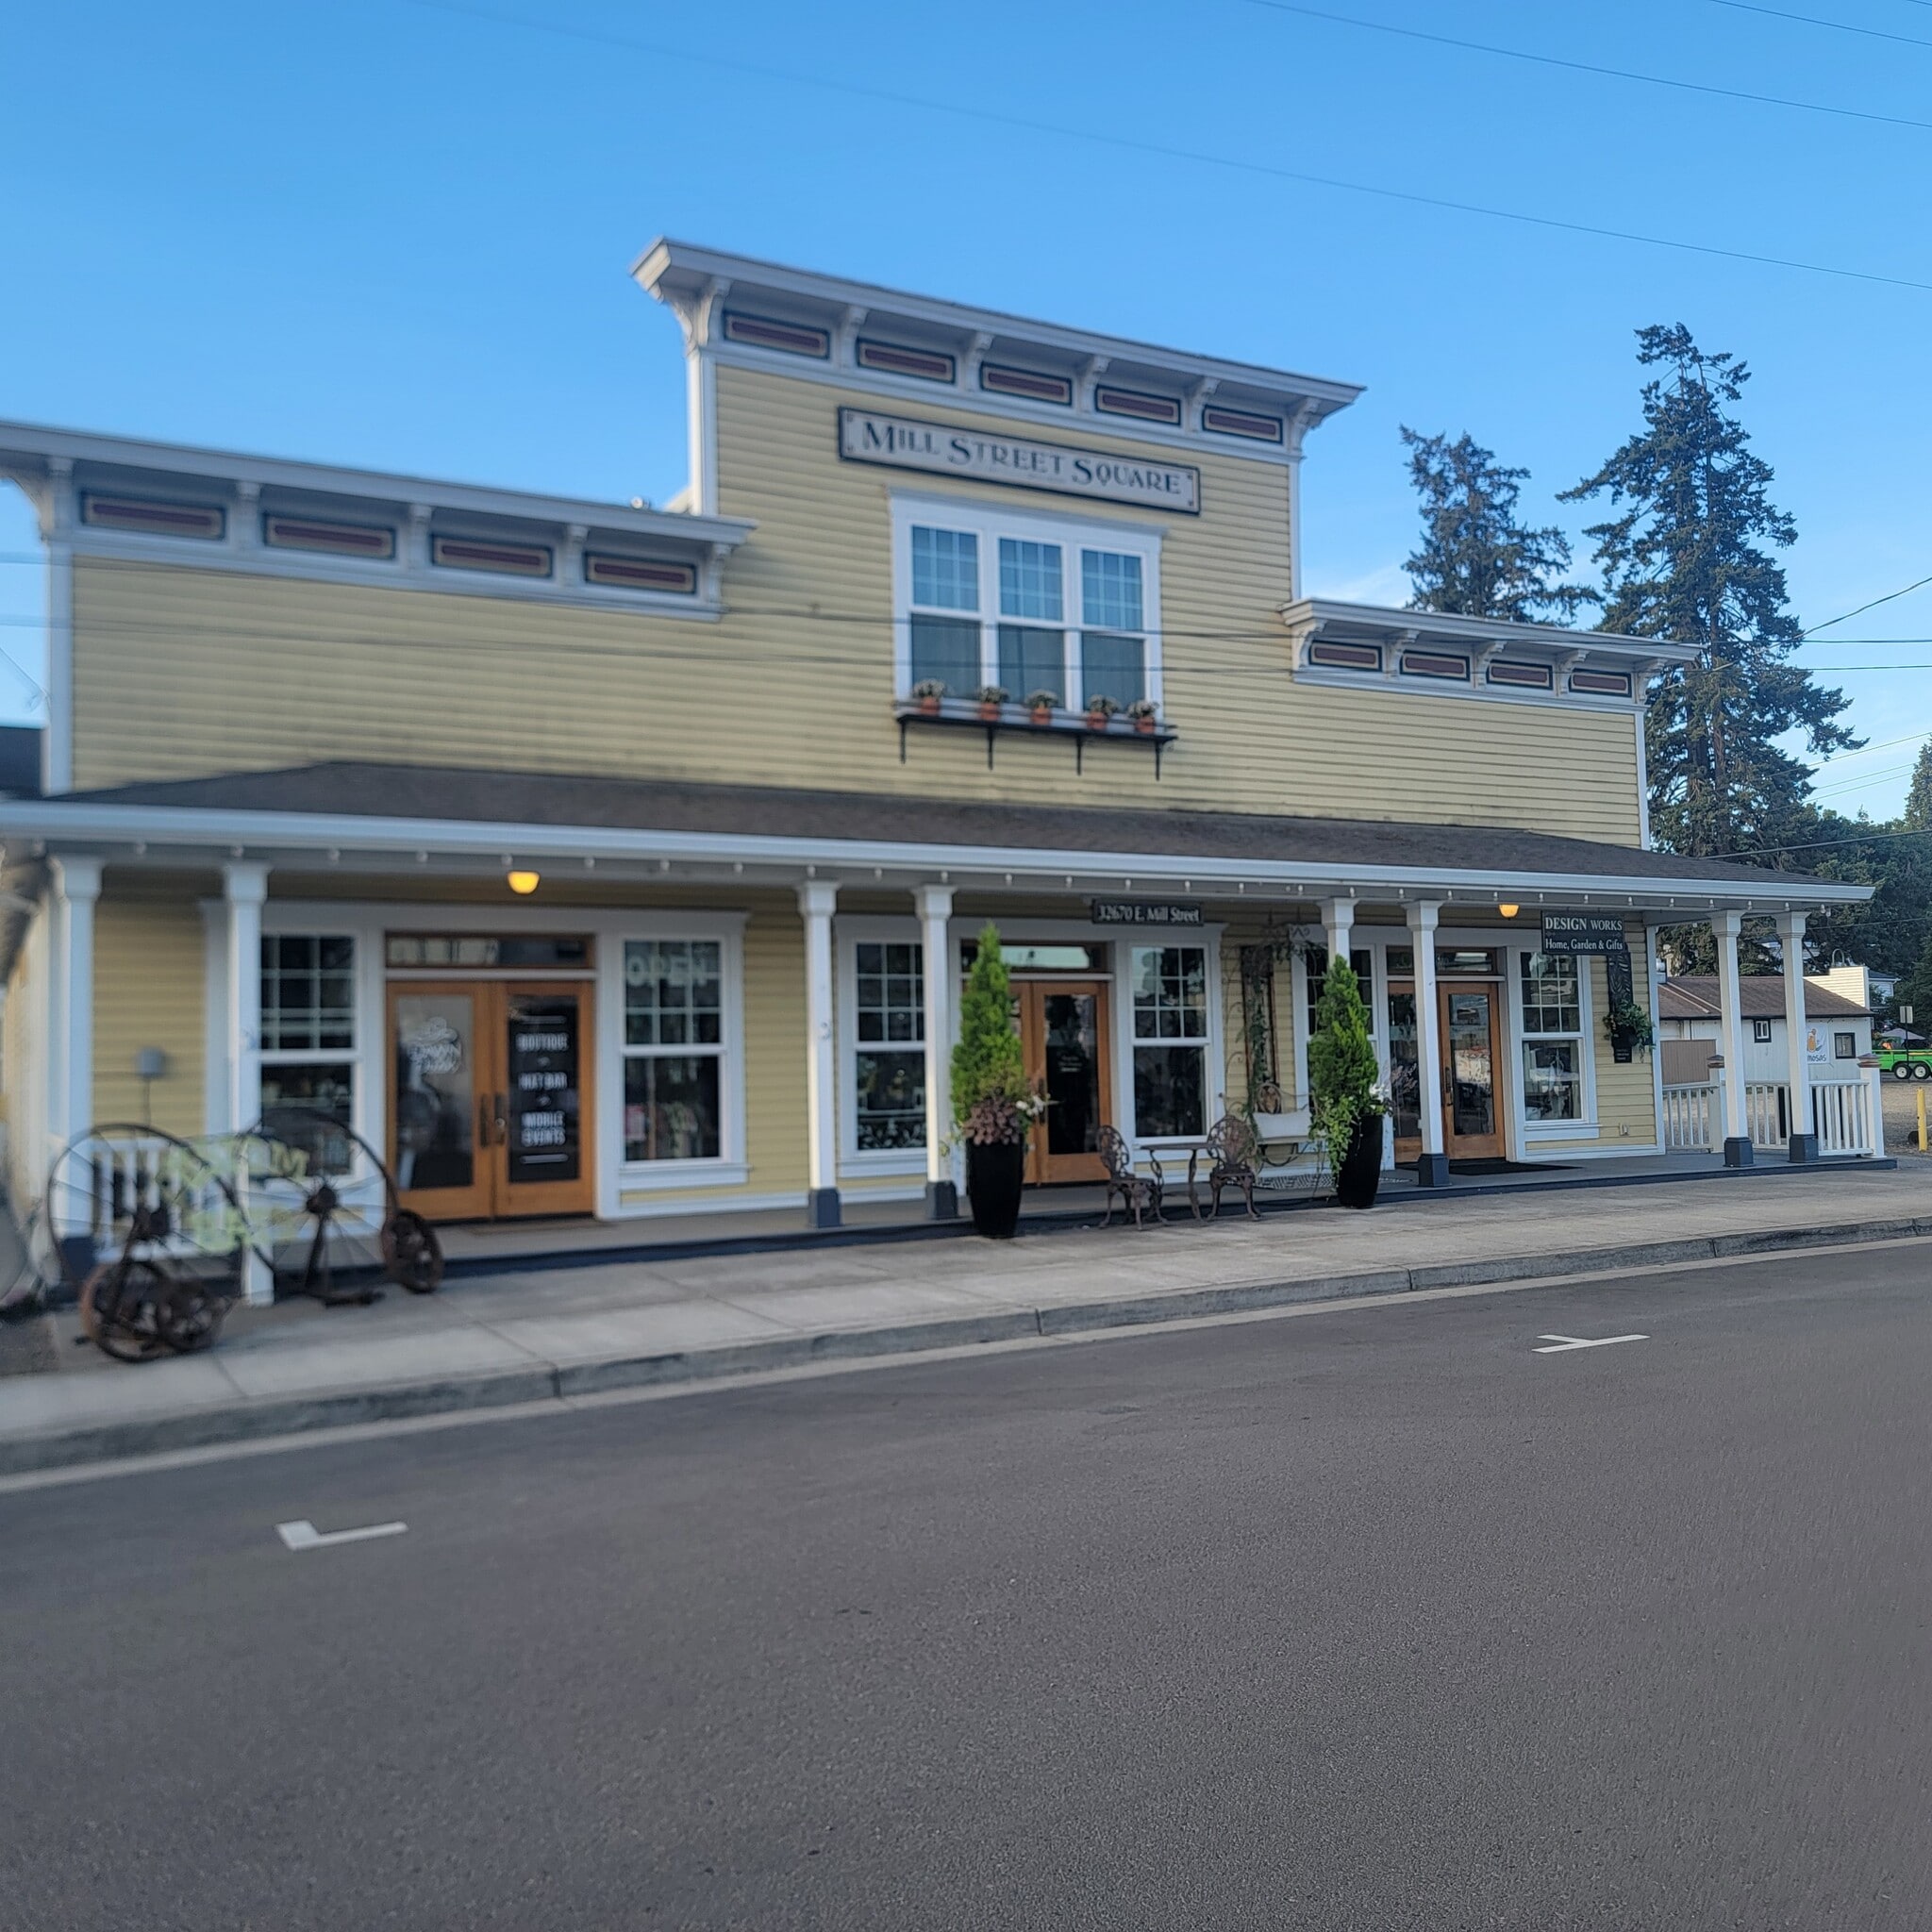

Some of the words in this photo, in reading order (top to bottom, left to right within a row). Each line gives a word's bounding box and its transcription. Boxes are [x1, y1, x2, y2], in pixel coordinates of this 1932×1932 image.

[862, 421, 939, 456] MILL
[947, 436, 1065, 475] STREET
[1072, 458, 1181, 494] SQUARE
[1146, 906, 1168, 921] Mill
[1170, 907, 1200, 923] Street
[1545, 917, 1587, 930] DESIGN
[1591, 920, 1623, 931] WORKS
[1545, 938, 1570, 951] Home,
[1571, 939, 1597, 950] Garden
[1598, 940, 1604, 950] &
[1606, 939, 1623, 950] Gifts
[625, 955, 707, 987] OPEN
